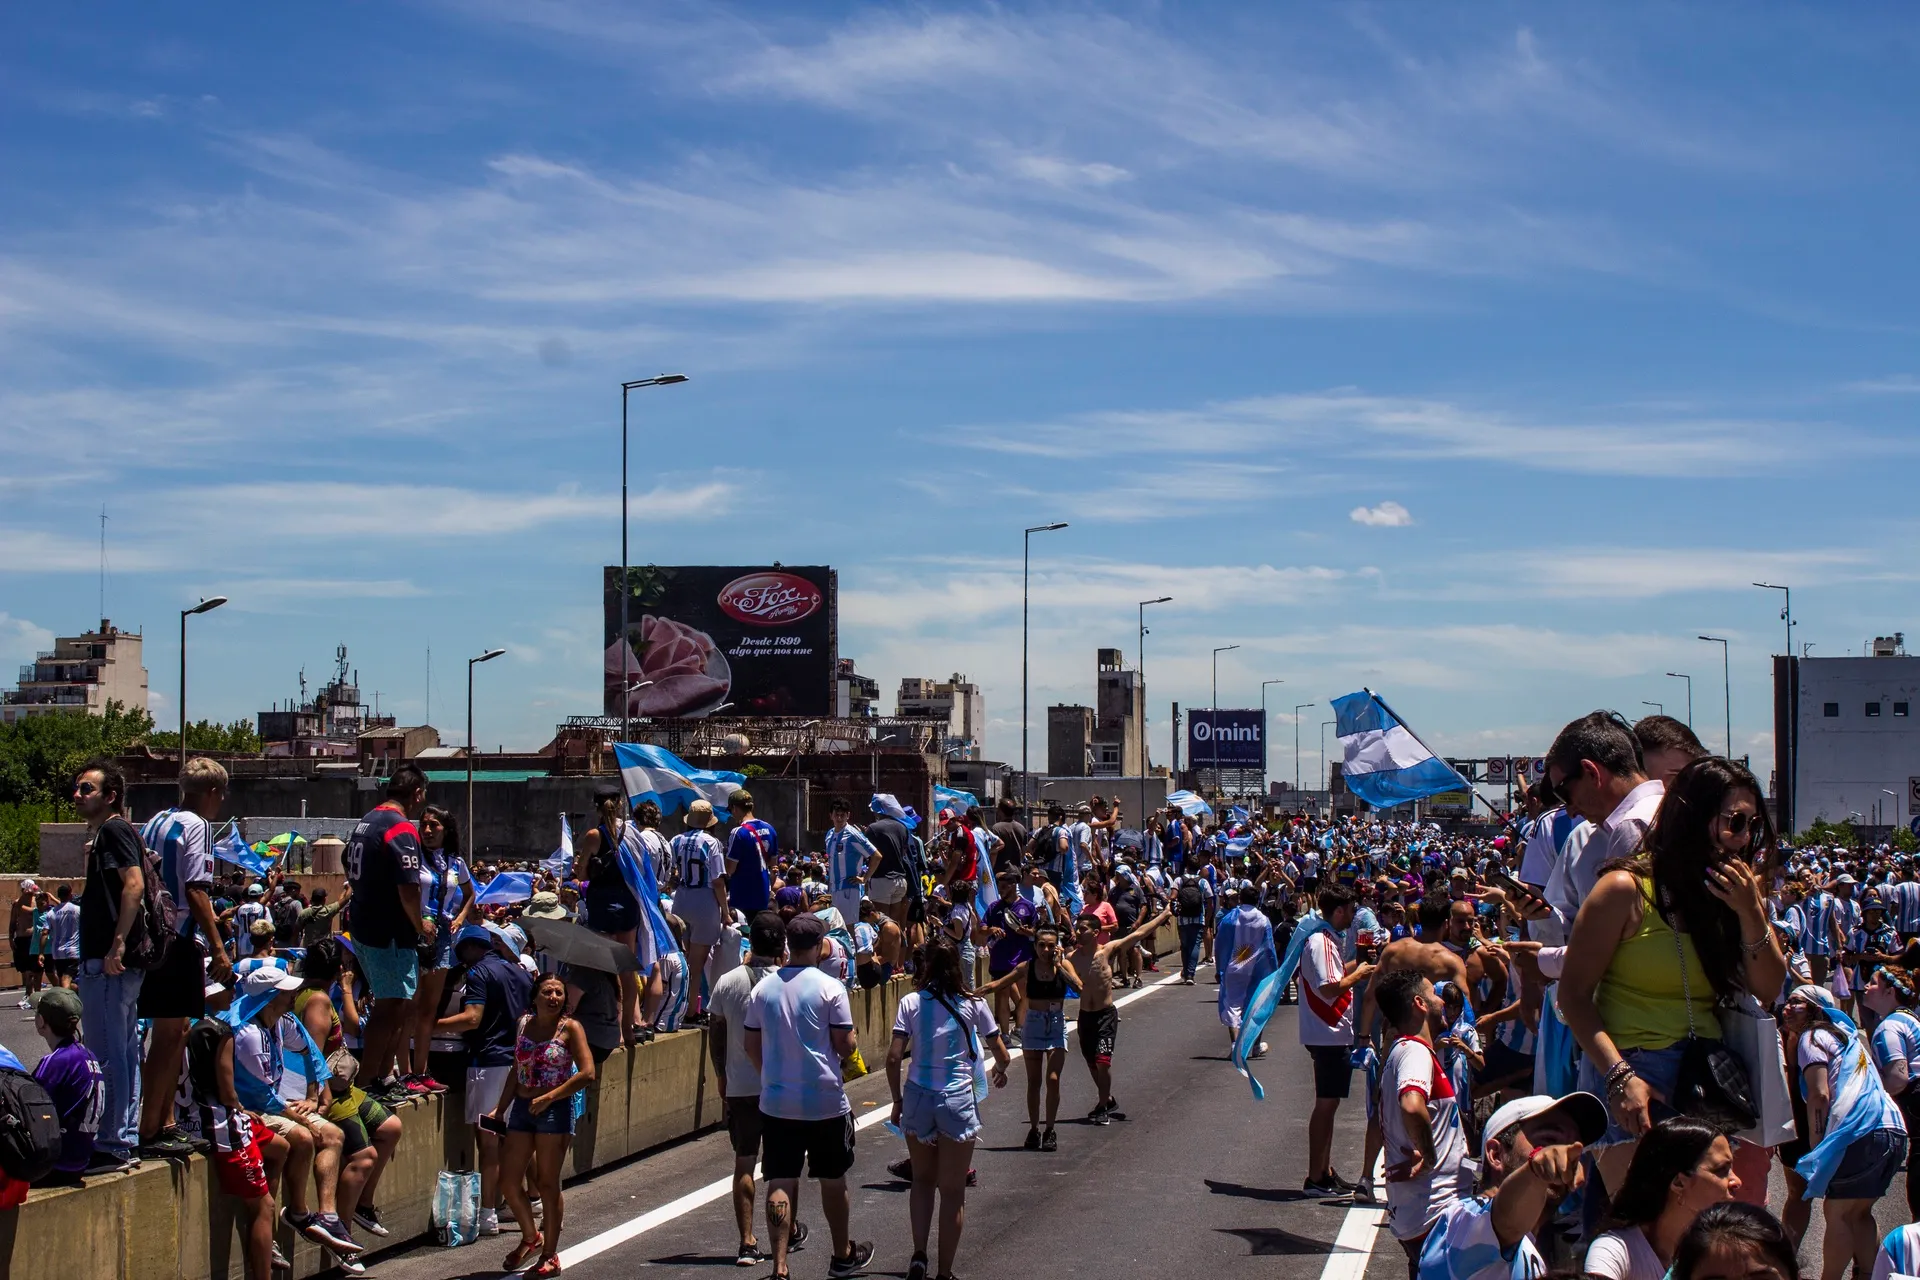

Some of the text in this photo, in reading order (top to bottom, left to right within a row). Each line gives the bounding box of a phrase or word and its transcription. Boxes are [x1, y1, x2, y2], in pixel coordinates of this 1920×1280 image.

[733, 582, 808, 615] Fox
[740, 636, 801, 646] Desde 1899
[729, 647, 751, 657] algo
[753, 648, 773, 657] que
[1193, 721, 1260, 741] Omint
[347, 841, 364, 880] 99
[401, 855, 419, 869] 99
[676, 855, 704, 888] 10
